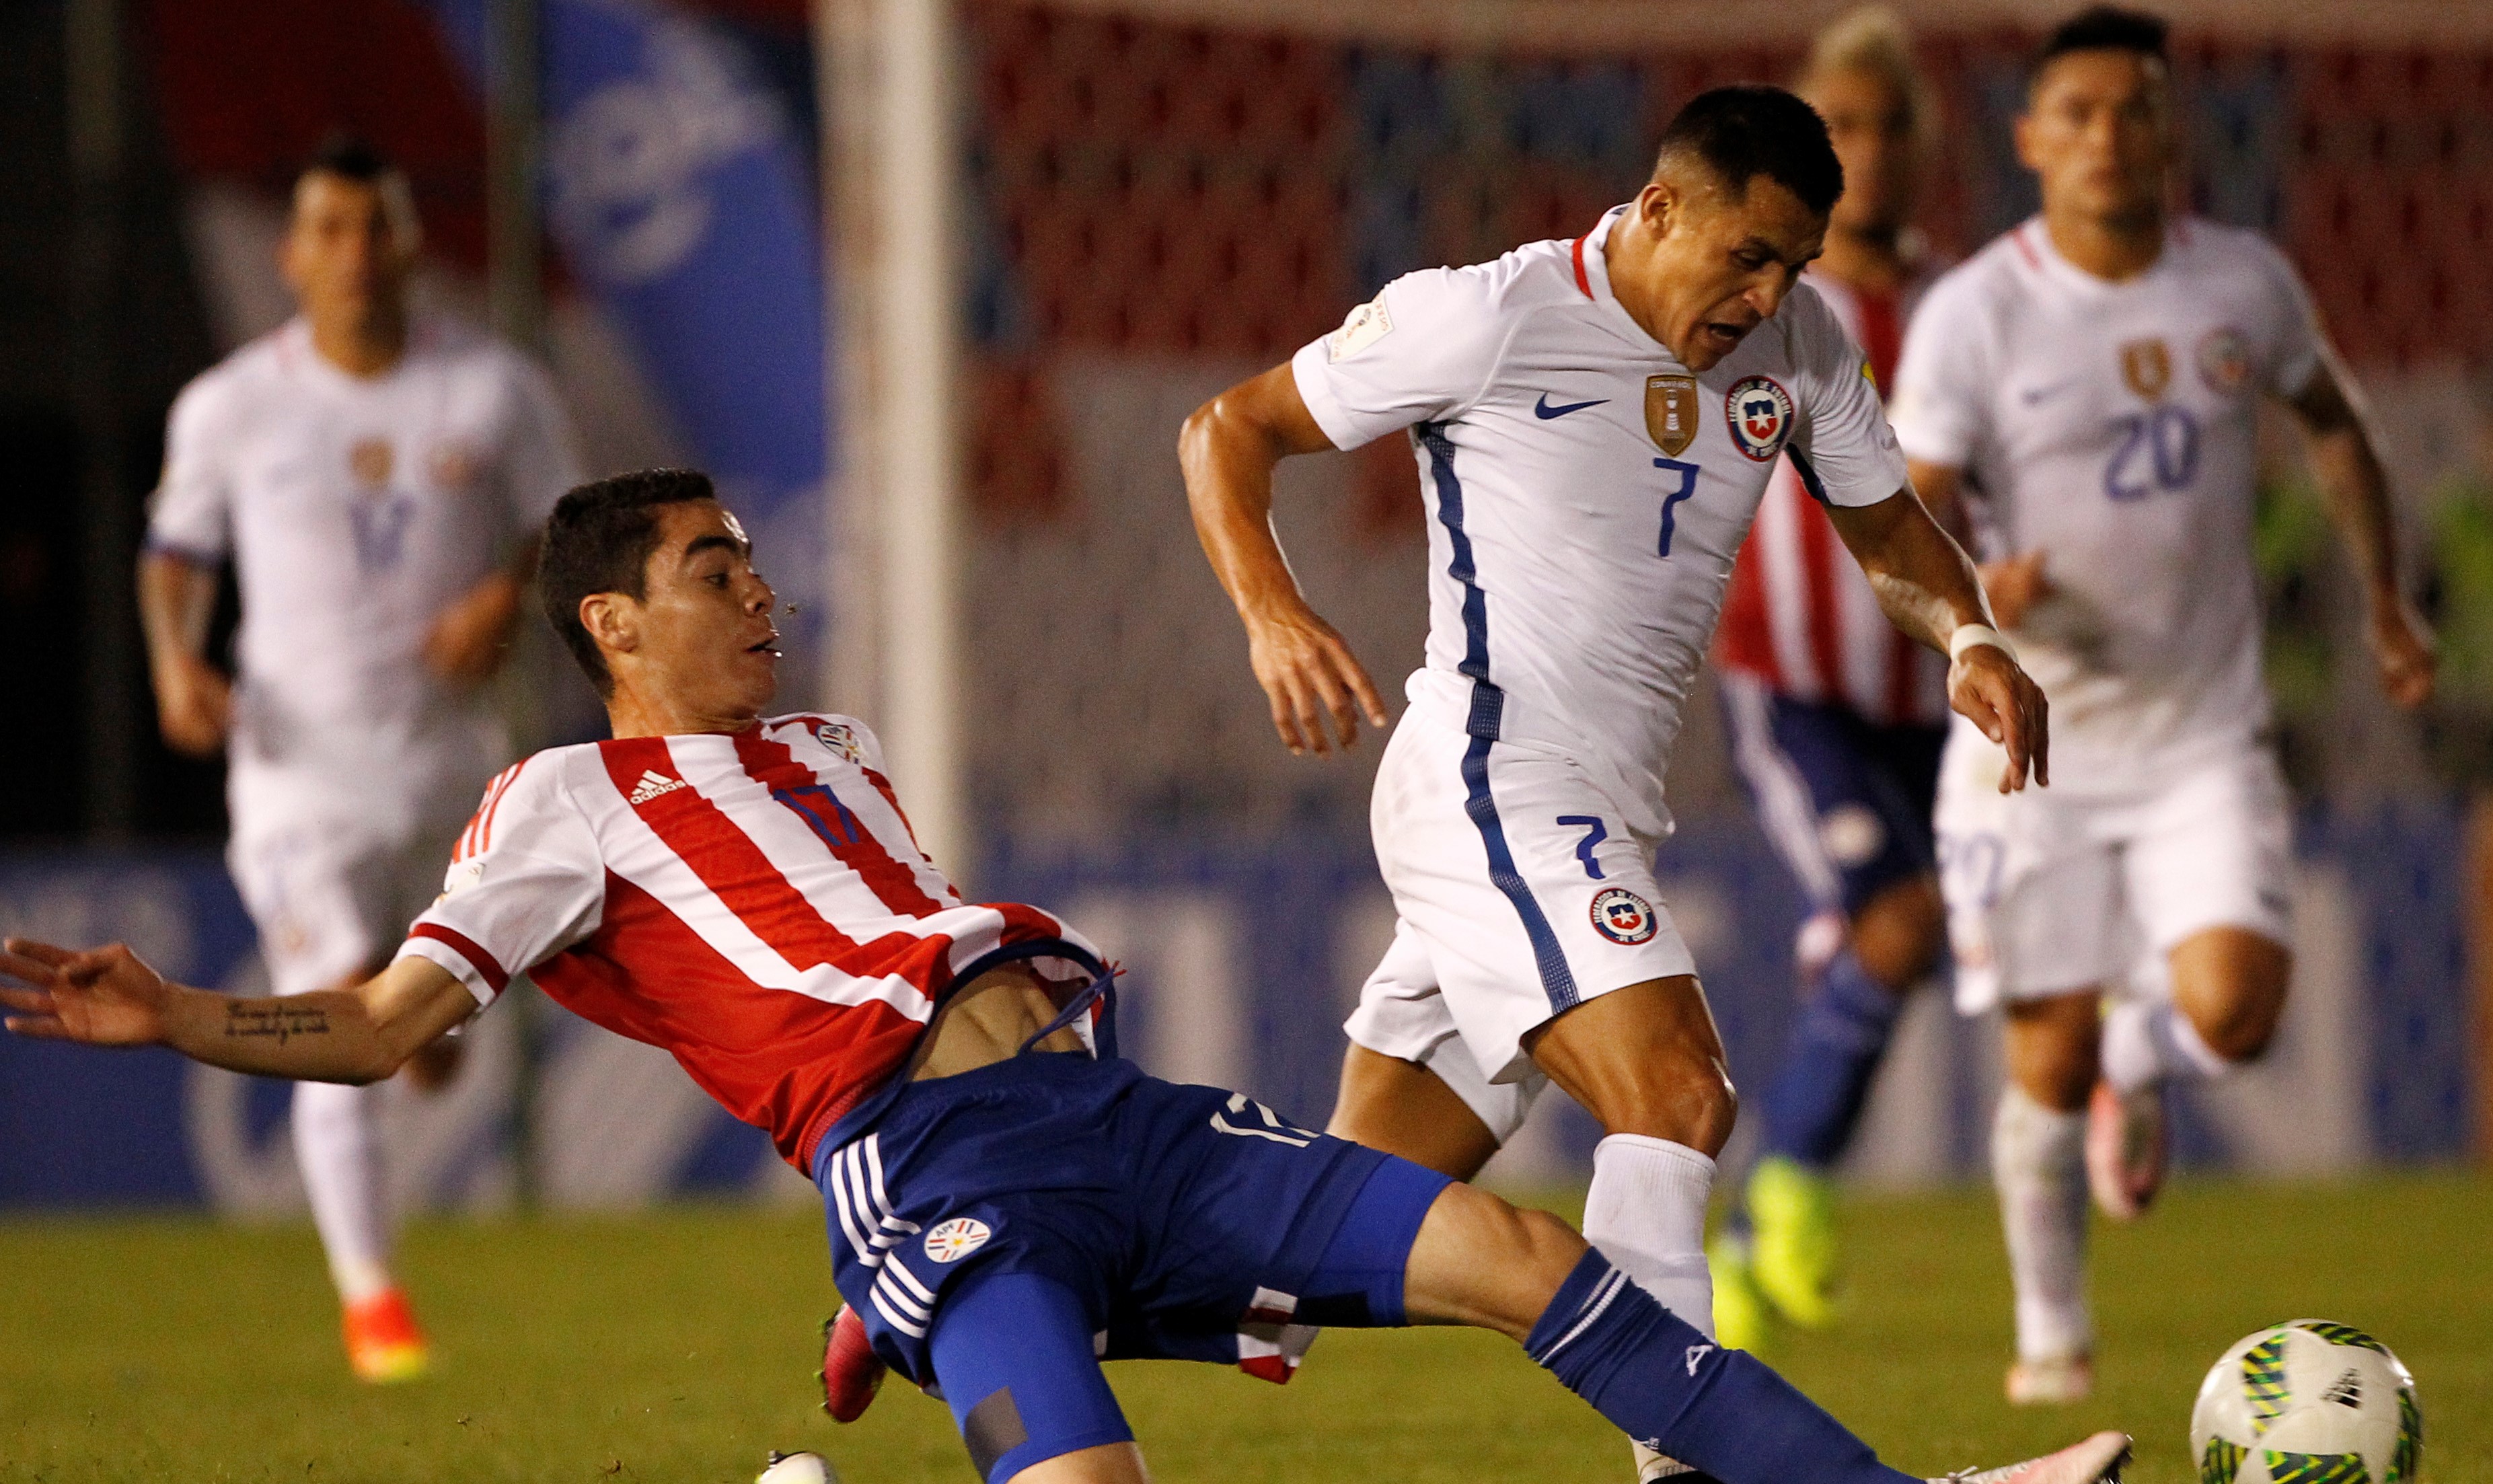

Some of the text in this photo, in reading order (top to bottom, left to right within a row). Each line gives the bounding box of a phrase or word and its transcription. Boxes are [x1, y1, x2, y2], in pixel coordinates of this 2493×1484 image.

[2104, 404, 2202, 501] 20
[1653, 457, 1700, 557] 7
[630, 780, 686, 805] adidas
[773, 784, 858, 846] 17
[1557, 815, 1607, 879] 7
